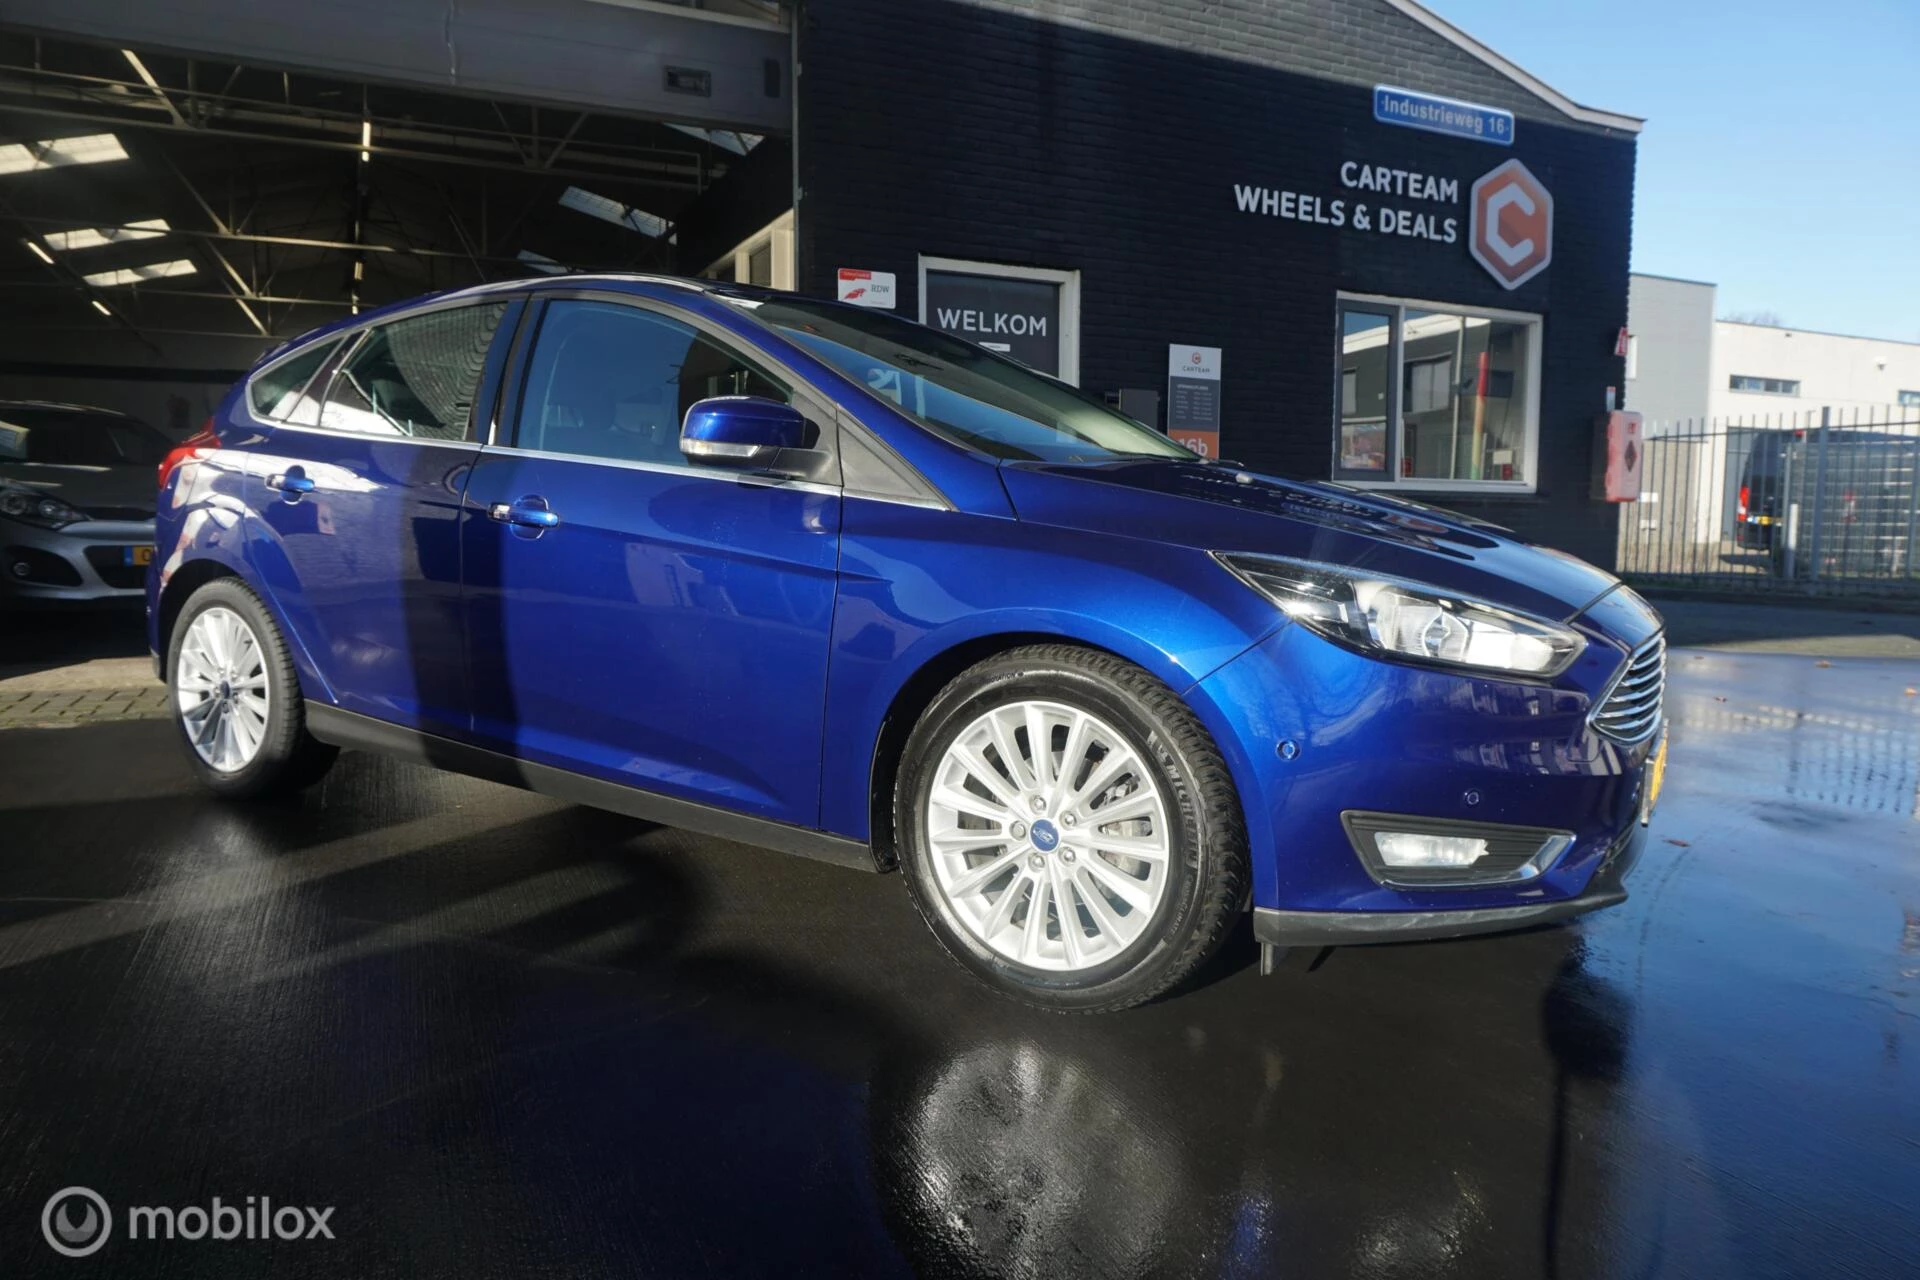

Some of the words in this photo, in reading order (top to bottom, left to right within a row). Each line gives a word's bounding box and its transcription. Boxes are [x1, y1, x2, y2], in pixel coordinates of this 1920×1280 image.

[1384, 94, 1483, 134] Industrieweg
[1489, 116, 1505, 134] 16
[1340, 161, 1458, 204] CARTEAM
[1234, 184, 1345, 227] WHEELS
[1352, 204, 1371, 231] &
[1379, 207, 1457, 244] DEALS
[871, 284, 890, 293] RDW
[937, 307, 1047, 337] WELKOM
